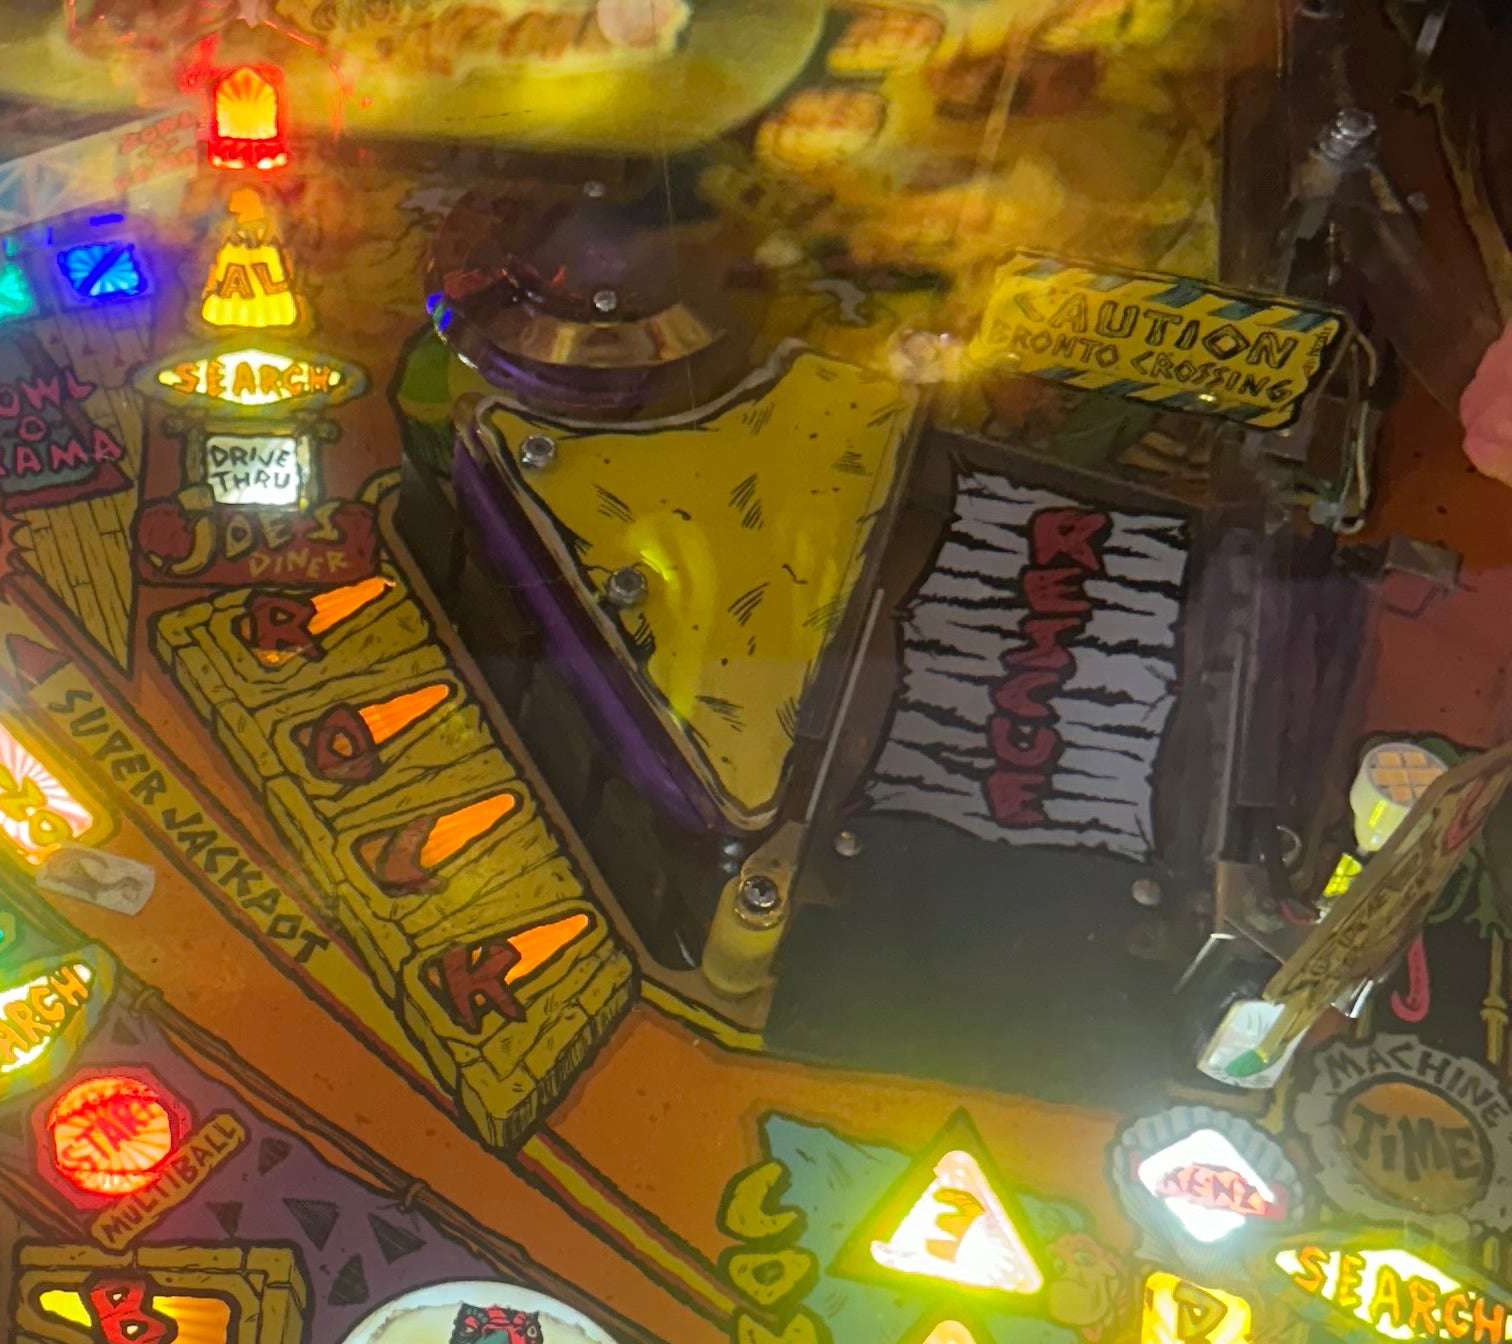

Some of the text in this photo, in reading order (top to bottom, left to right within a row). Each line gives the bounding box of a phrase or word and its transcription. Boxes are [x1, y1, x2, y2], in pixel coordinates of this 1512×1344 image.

[987, 318, 1120, 369] BRONTO
[1130, 349, 1293, 404] CROSSING
[1014, 291, 1297, 370] CAUTION
[173, 360, 331, 399] SEARCH
[208, 445, 292, 469] DRIVE
[211, 471, 292, 494] THRU
[248, 546, 349, 580] DINER
[985, 506, 1112, 829] RESCUE
[48, 688, 330, 963] SUPER JACKPOT
[1330, 1042, 1512, 1130] MACHINE
[100, 1116, 237, 1245] MULTIBALL
[1350, 1102, 1483, 1184] TIME
